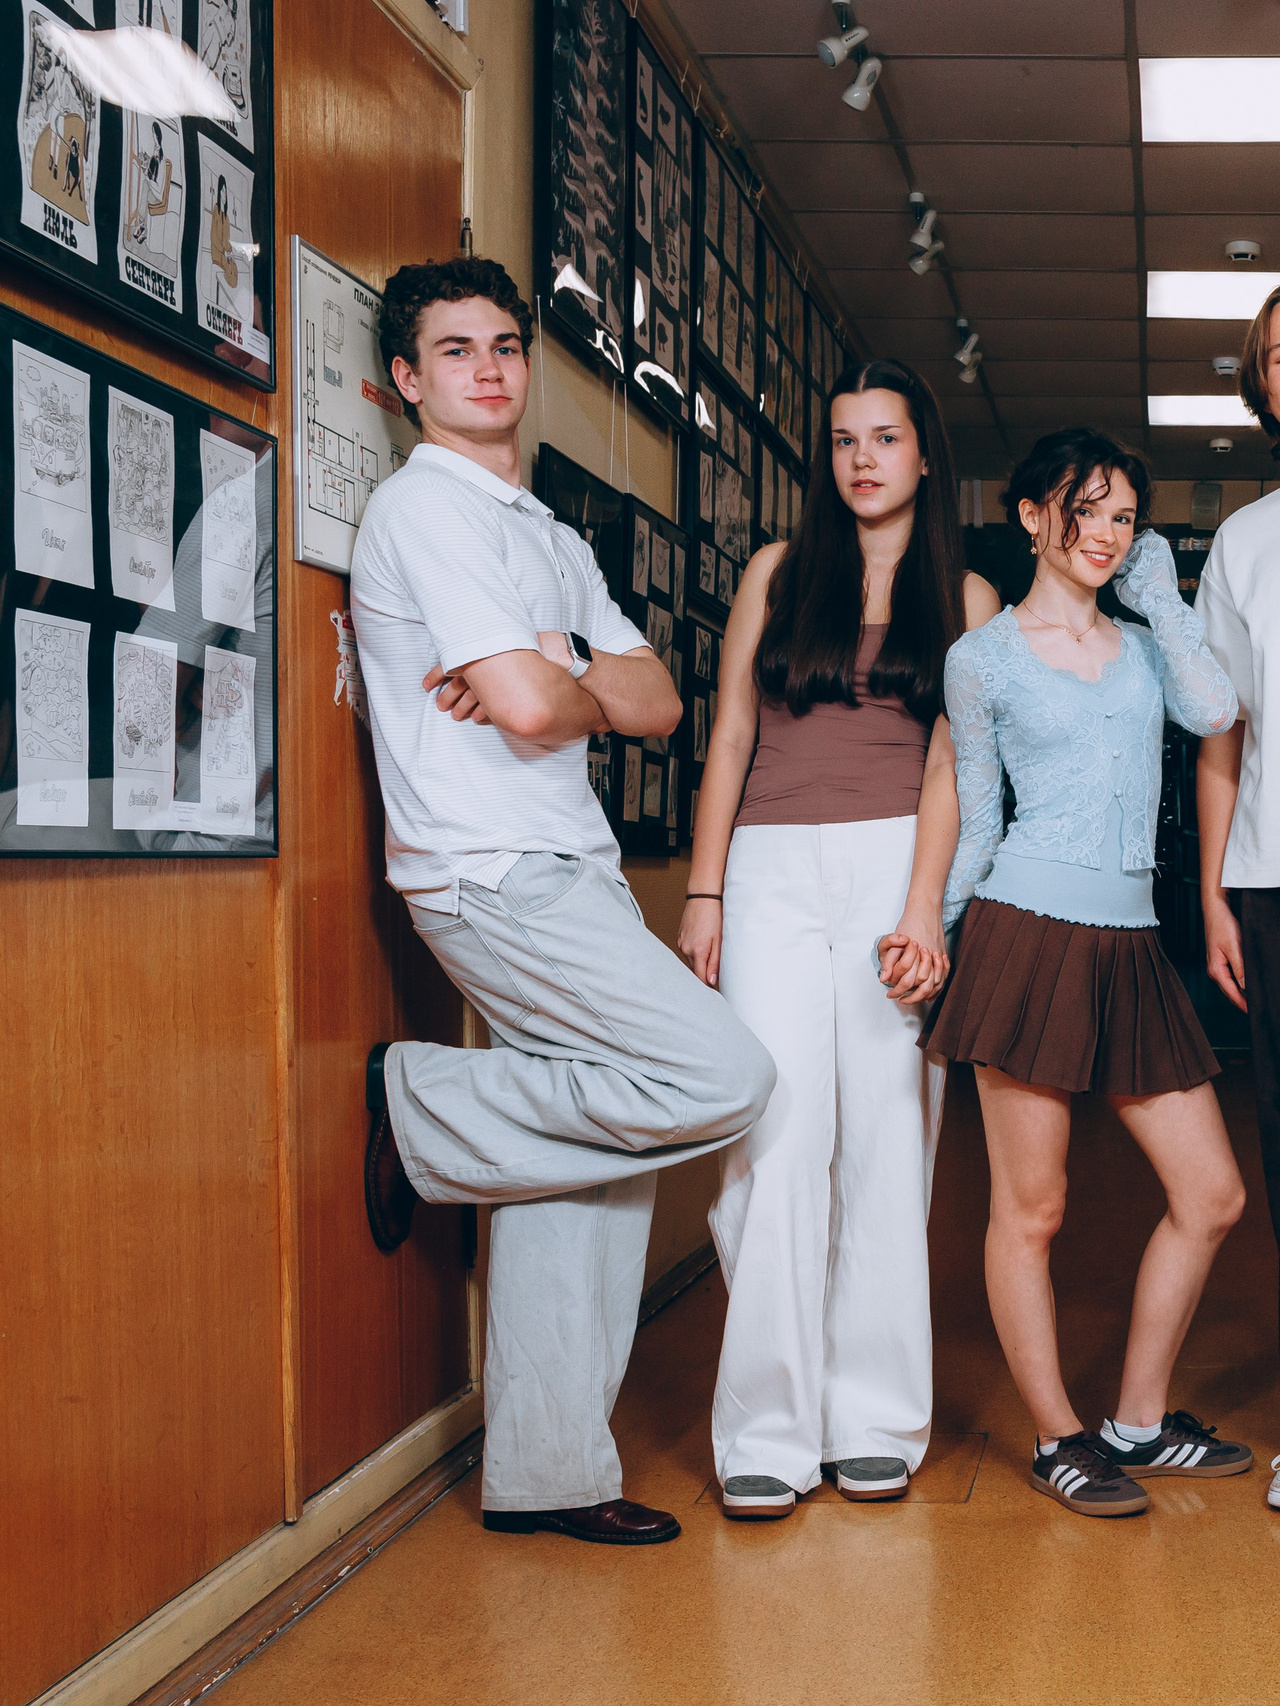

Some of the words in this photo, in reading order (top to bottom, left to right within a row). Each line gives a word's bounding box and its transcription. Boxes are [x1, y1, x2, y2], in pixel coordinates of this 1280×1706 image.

[43, 202, 78, 249] ИЮЛЬ
[125, 255, 176, 306] СЕНТЯБРЬ
[353, 287, 373, 312] ПЛАН
[206, 303, 243, 346] ОКТЯБРЬ
